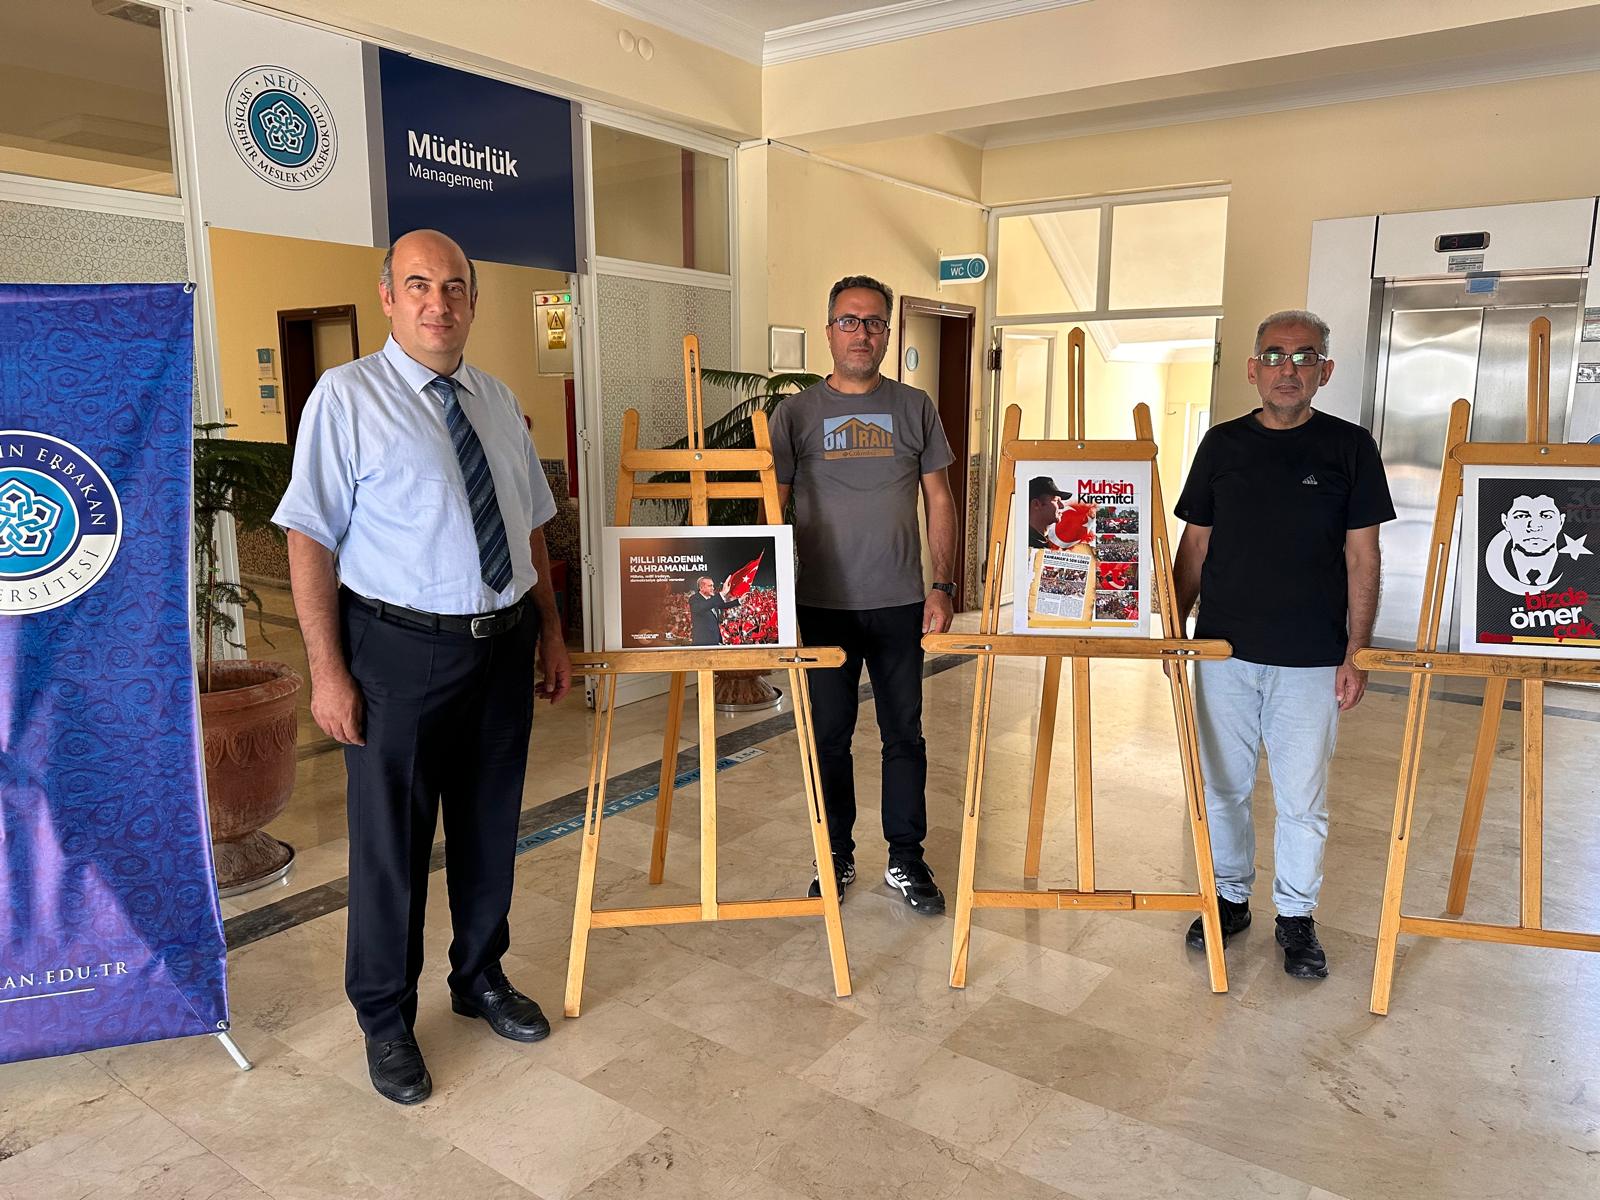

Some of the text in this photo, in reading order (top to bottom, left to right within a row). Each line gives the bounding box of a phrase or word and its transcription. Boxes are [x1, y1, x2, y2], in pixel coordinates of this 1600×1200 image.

[263, 74, 299, 93] NEÜ
[234, 87, 330, 183] SEYDİŞEHİR MESLEK YÜKSEKOKULU
[407, 130, 519, 178] Müdürlük
[409, 162, 494, 192] Management
[950, 267, 965, 276] WC
[823, 430, 847, 451] ON
[36, 447, 107, 526] ERBAKAN
[1077, 479, 1134, 495] Muhsin
[629, 564, 708, 573] KAHRAMANLARI
[1525, 587, 1589, 610] bizde
[1510, 607, 1583, 630] ömer
[1553, 618, 1596, 643] çok
[0, 961, 129, 990] AN.EDU.TR
